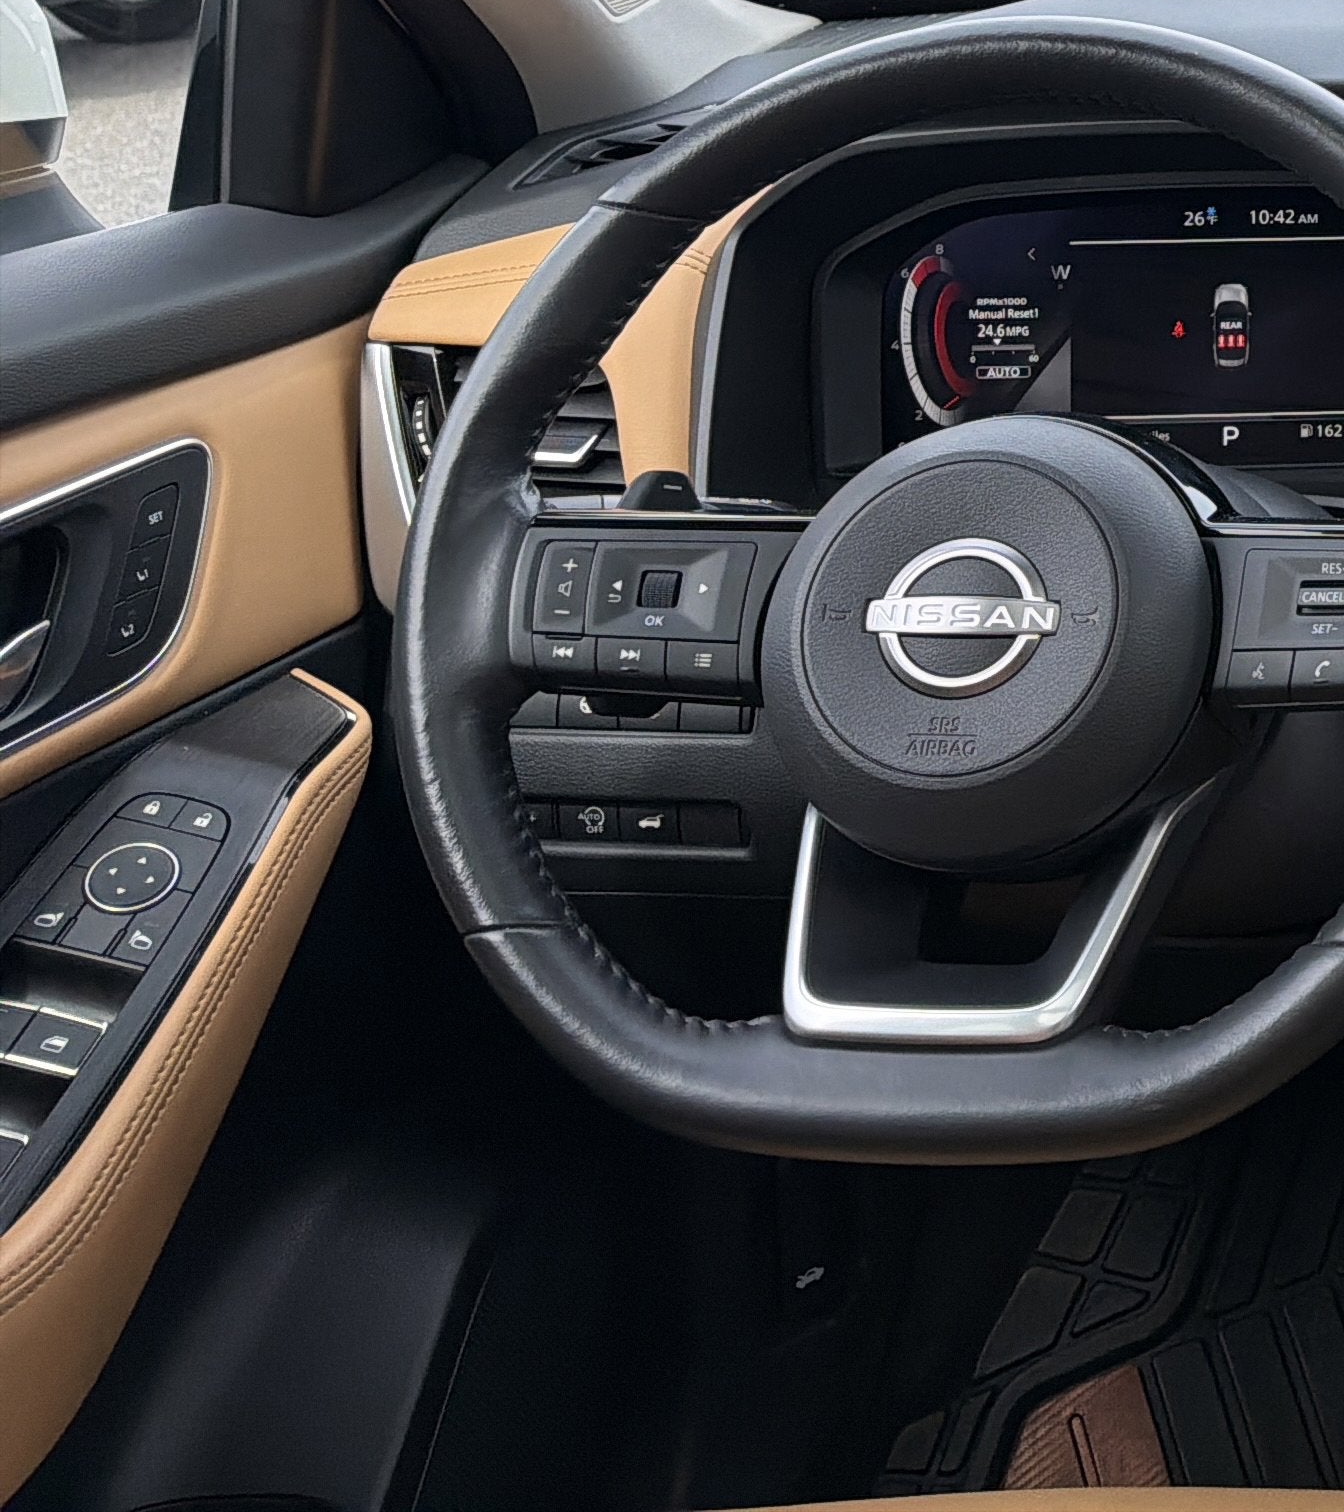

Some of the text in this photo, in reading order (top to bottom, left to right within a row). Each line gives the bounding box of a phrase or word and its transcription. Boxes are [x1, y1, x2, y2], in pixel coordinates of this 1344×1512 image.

[1250, 209, 1319, 225] 10:42 AM
[935, 244, 944, 254] 8
[901, 268, 909, 278] 6
[969, 309, 1005, 319] Manual
[977, 323, 1030, 337] 24.6 MPG
[1220, 321, 1243, 329] REAR
[891, 341, 899, 350] 4
[987, 367, 1020, 377] AUTO
[1223, 426, 1239, 446] P
[1317, 424, 1342, 438] 162
[148, 511, 164, 525] SET
[645, 615, 665, 627] OK
[870, 603, 1055, 630] NISSAN
[927, 717, 961, 731] SRS
[905, 740, 976, 757] AIRBAG
[577, 813, 600, 821] AUTO
[586, 825, 604, 834] OFF
